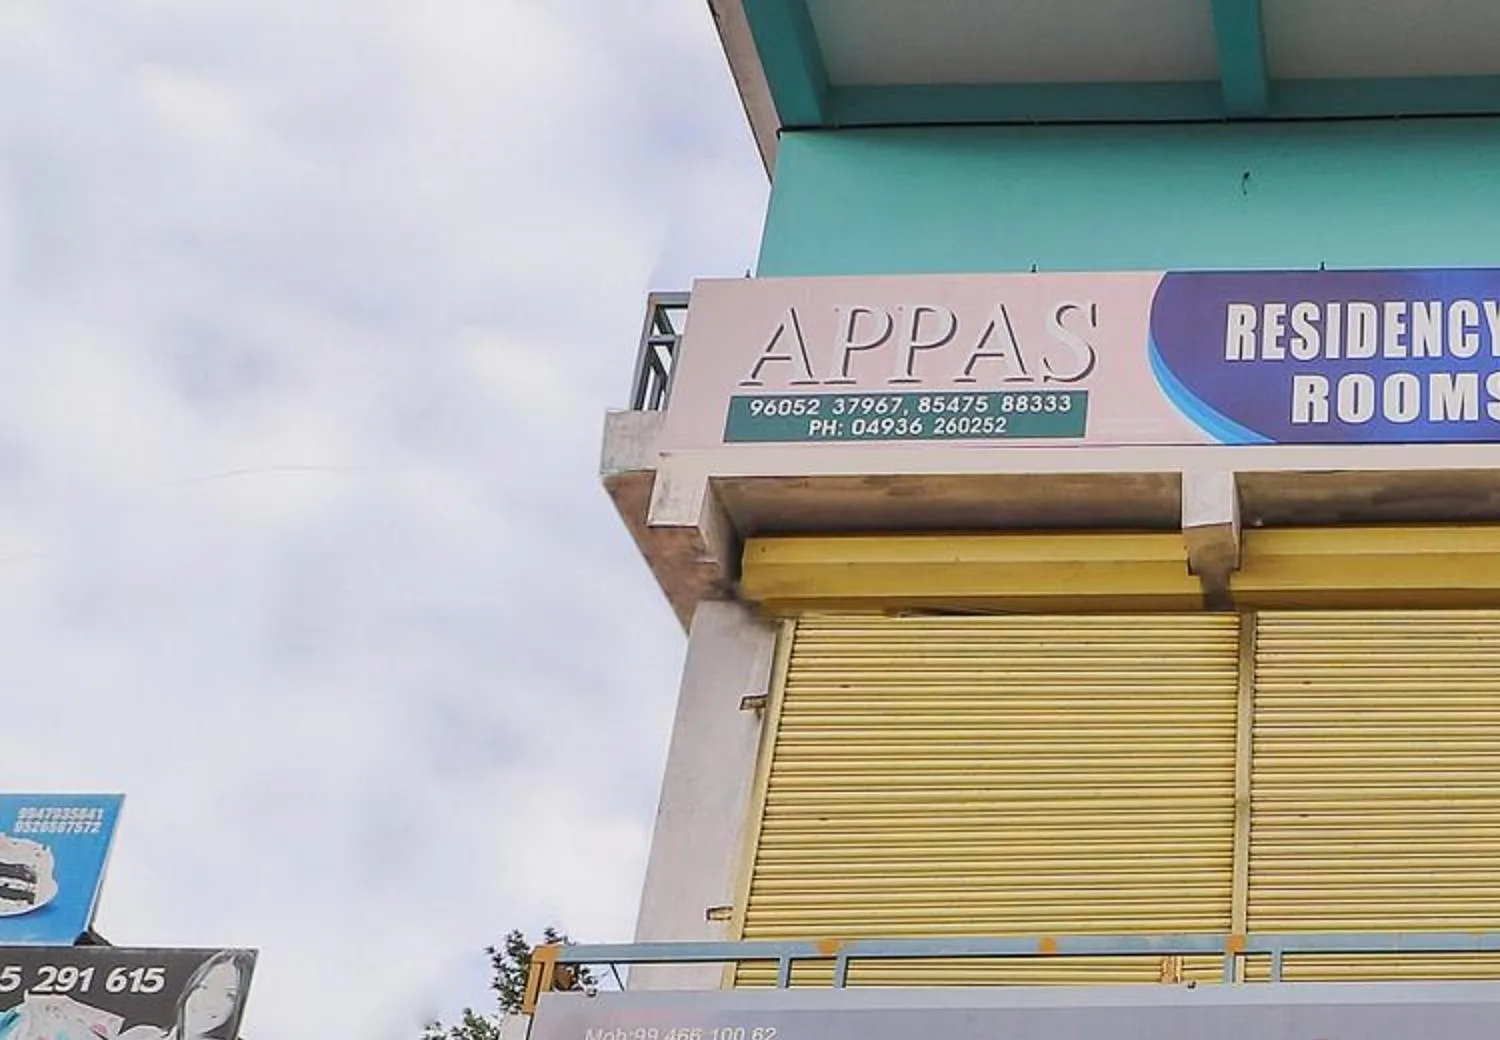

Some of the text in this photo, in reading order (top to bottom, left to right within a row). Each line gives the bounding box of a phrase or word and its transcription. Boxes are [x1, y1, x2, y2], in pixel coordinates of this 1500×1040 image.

[737, 302, 1099, 387] APPAS
[749, 396, 1071, 417] 96052 37967, 85475 88333
[808, 417, 1007, 437] PH: 04936 260252
[0, 965, 166, 993] 5 291 615
